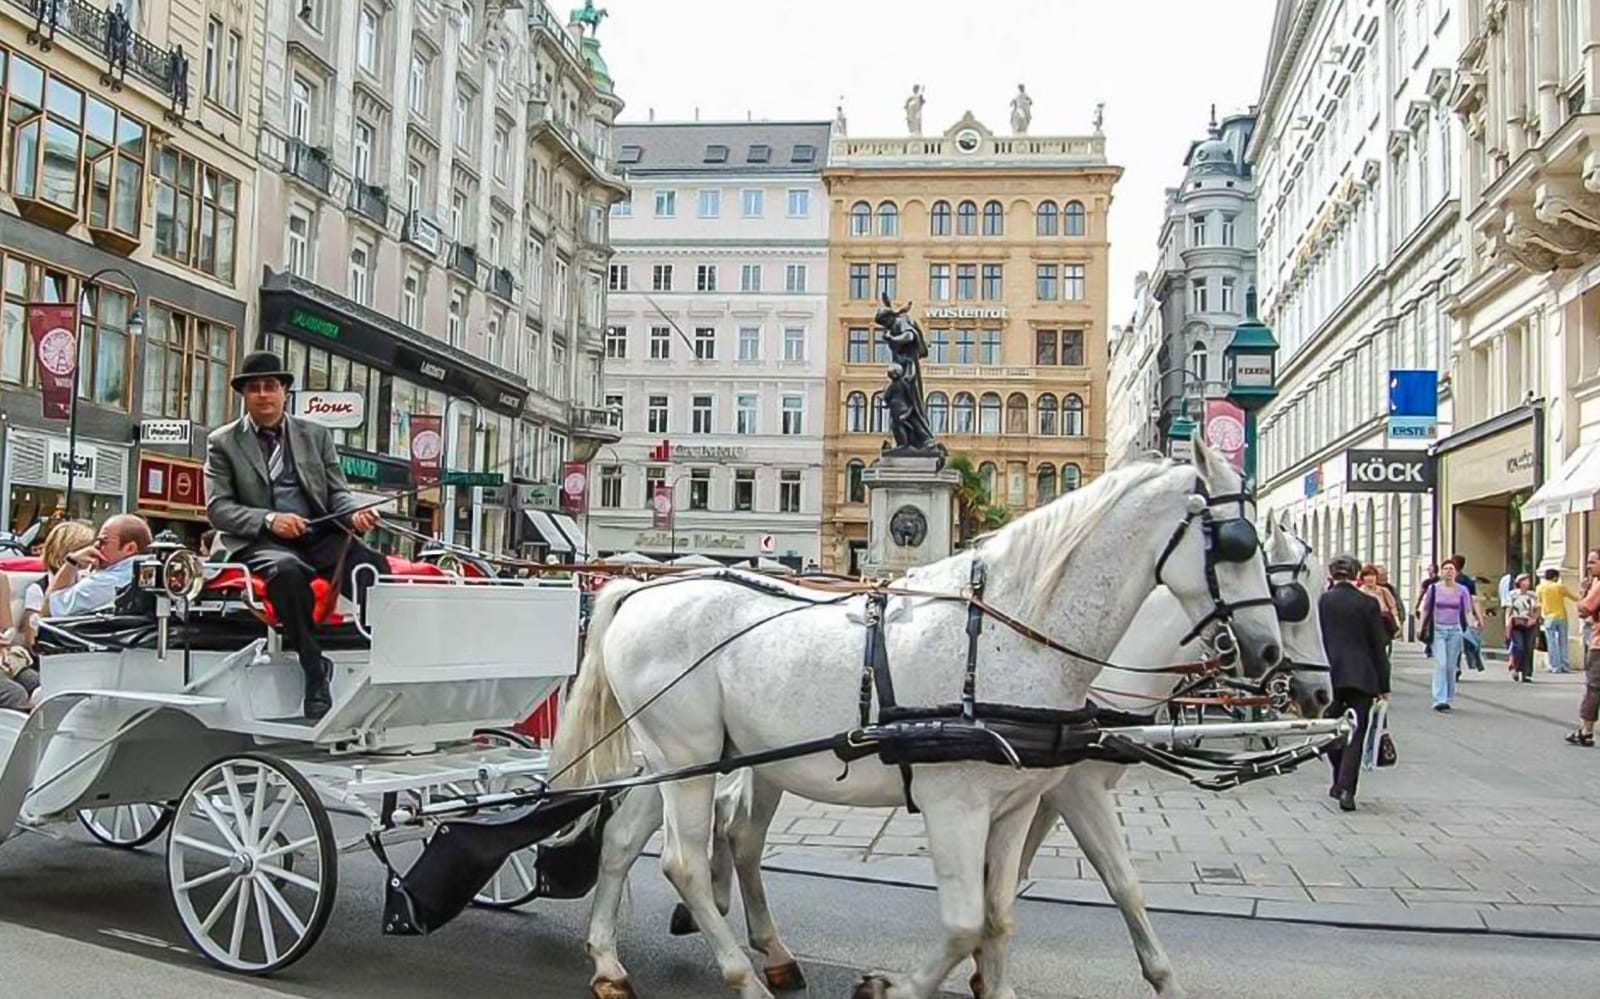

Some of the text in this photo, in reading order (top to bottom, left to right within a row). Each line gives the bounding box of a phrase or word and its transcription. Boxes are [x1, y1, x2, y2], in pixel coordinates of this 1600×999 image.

[304, 396, 353, 414] Sioux
[1393, 426, 1425, 436] ERSTE
[1351, 457, 1424, 482] KÖCK
